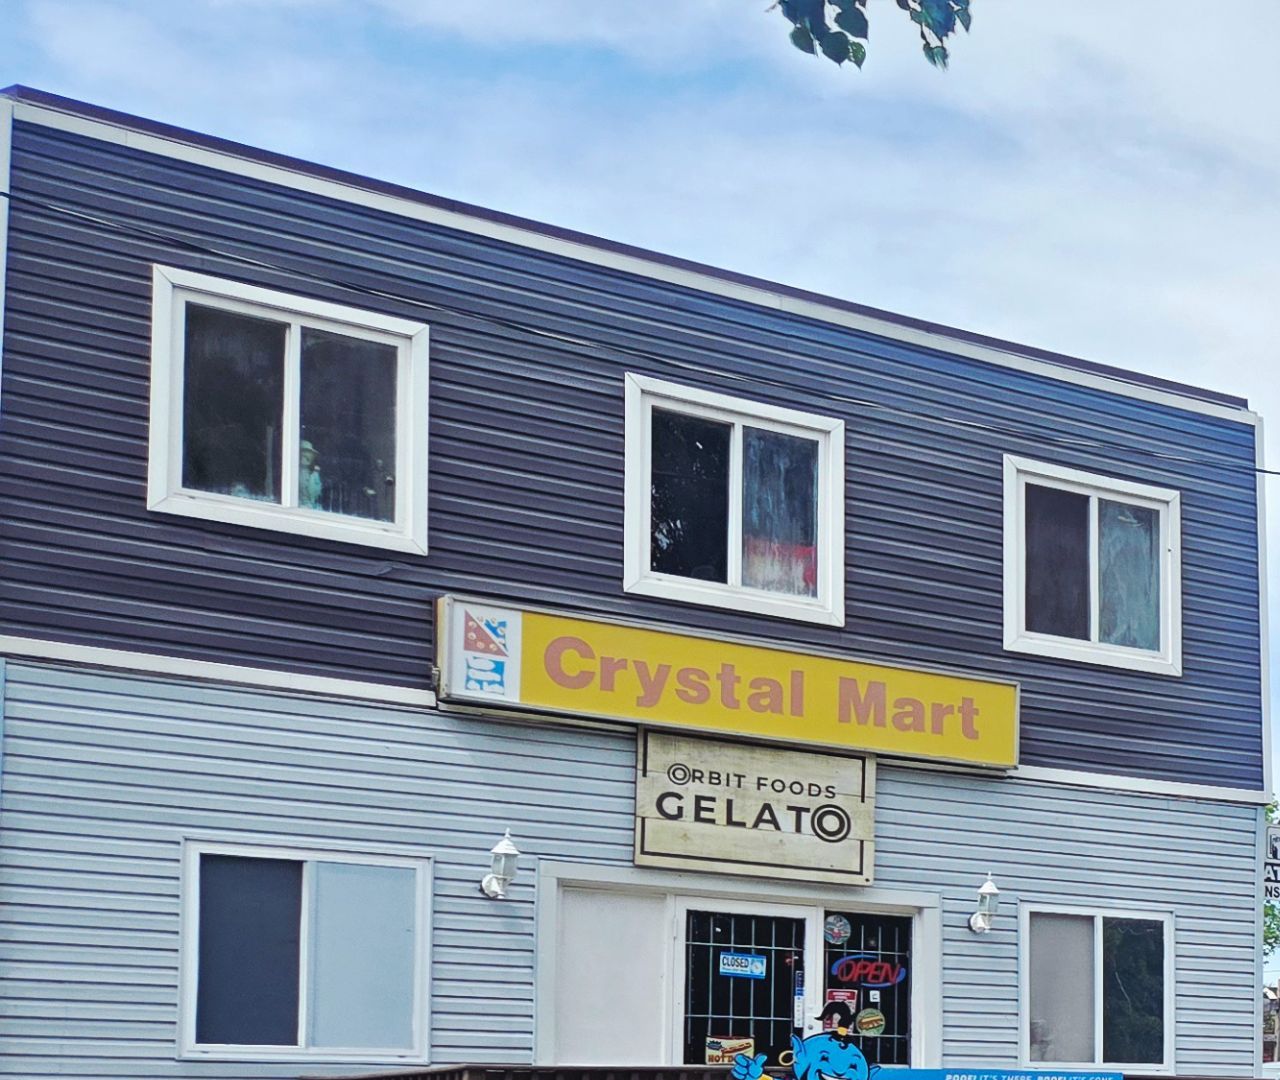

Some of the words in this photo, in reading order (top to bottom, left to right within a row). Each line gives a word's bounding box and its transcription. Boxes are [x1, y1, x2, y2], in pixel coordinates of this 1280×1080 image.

[544, 636, 805, 717] Crystal
[838, 676, 980, 740] Mart
[667, 763, 746, 788] ORBIT
[756, 777, 836, 799] FOODS
[655, 791, 851, 843] GELATO
[721, 956, 750, 968] CLOSED
[838, 961, 900, 984] OPEN
